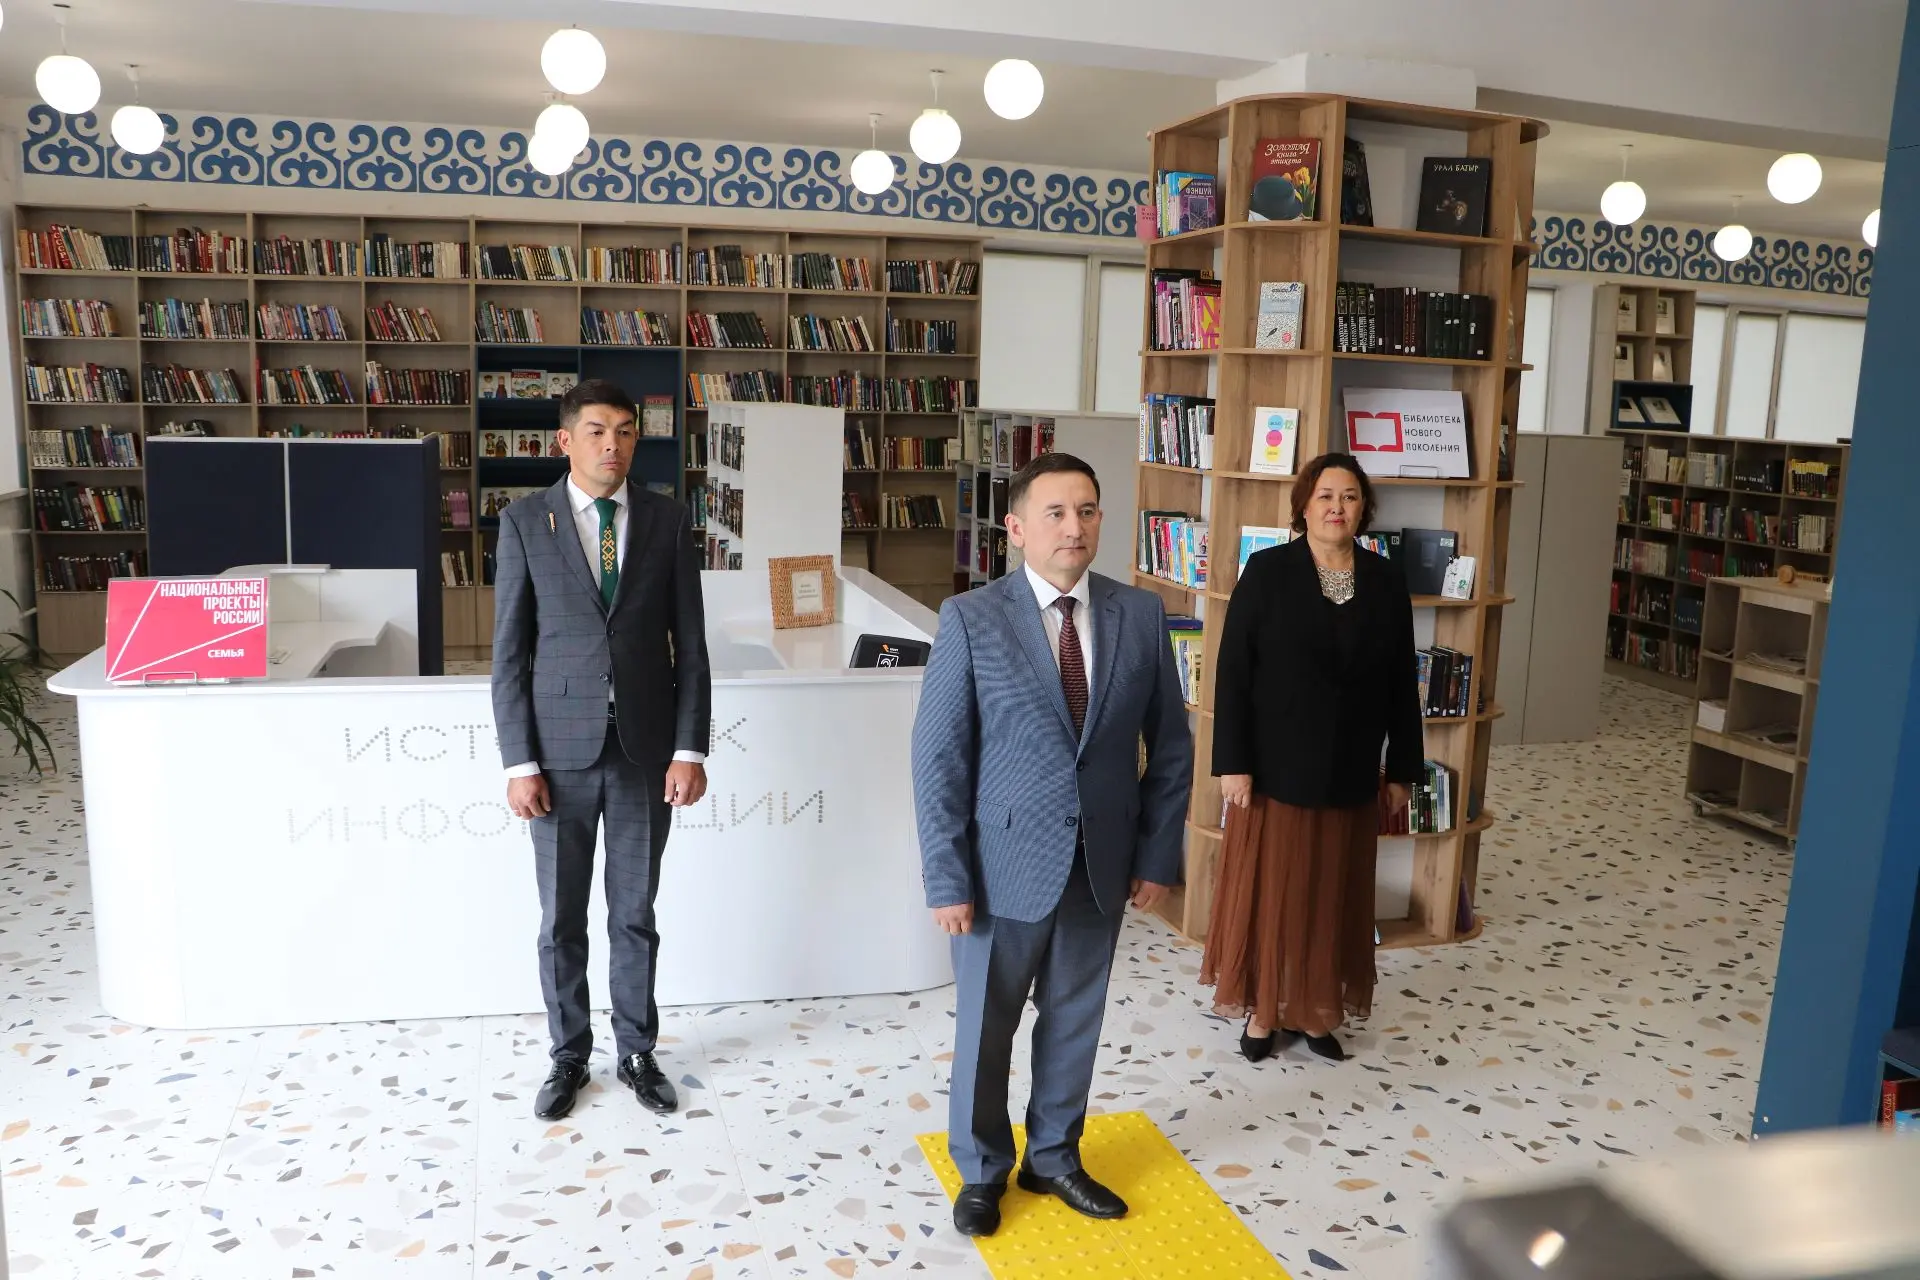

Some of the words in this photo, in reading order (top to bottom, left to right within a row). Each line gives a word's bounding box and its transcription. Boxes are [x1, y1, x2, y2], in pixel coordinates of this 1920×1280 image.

[1276, 151, 1297, 159] книга
[1433, 164, 1453, 172] УРАЛ
[1455, 164, 1479, 172] БАТЫР
[1403, 414, 1461, 424] БИБЛИОТЕКА
[1404, 428, 1442, 437] НОВОГО
[1406, 443, 1460, 453] ПОКОЛЕНИЯ
[160, 581, 261, 598] НАЦИОНАЛЬНЫЕ
[203, 595, 261, 610] ПРОЕКТЫ
[213, 609, 260, 625] РОССИИ
[207, 649, 245, 658] СЕМЬЯ
[286, 789, 823, 844] ИНФОЦИИ
